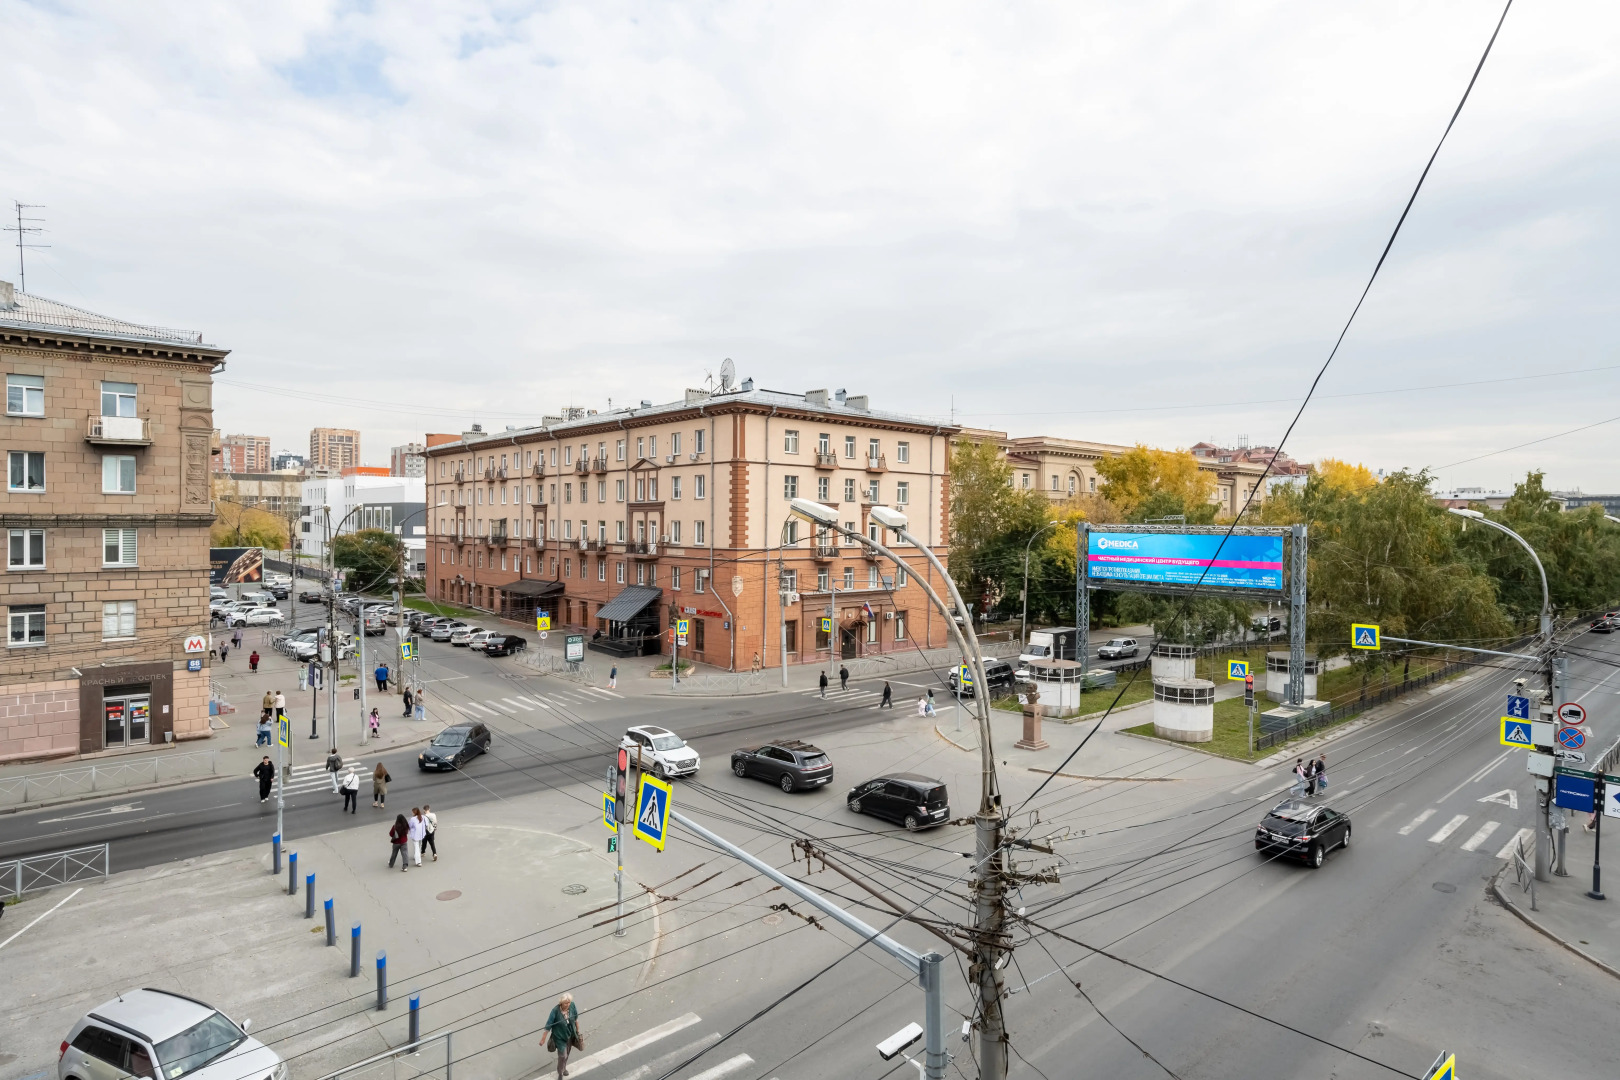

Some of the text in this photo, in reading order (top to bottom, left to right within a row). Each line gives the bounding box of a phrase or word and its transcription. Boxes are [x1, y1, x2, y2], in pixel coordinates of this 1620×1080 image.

[1120, 556, 1156, 564] МЕДИЦИНСКИЙ
[188, 639, 202, 650] М
[82, 675, 124, 686] КРАСНЫЙ
